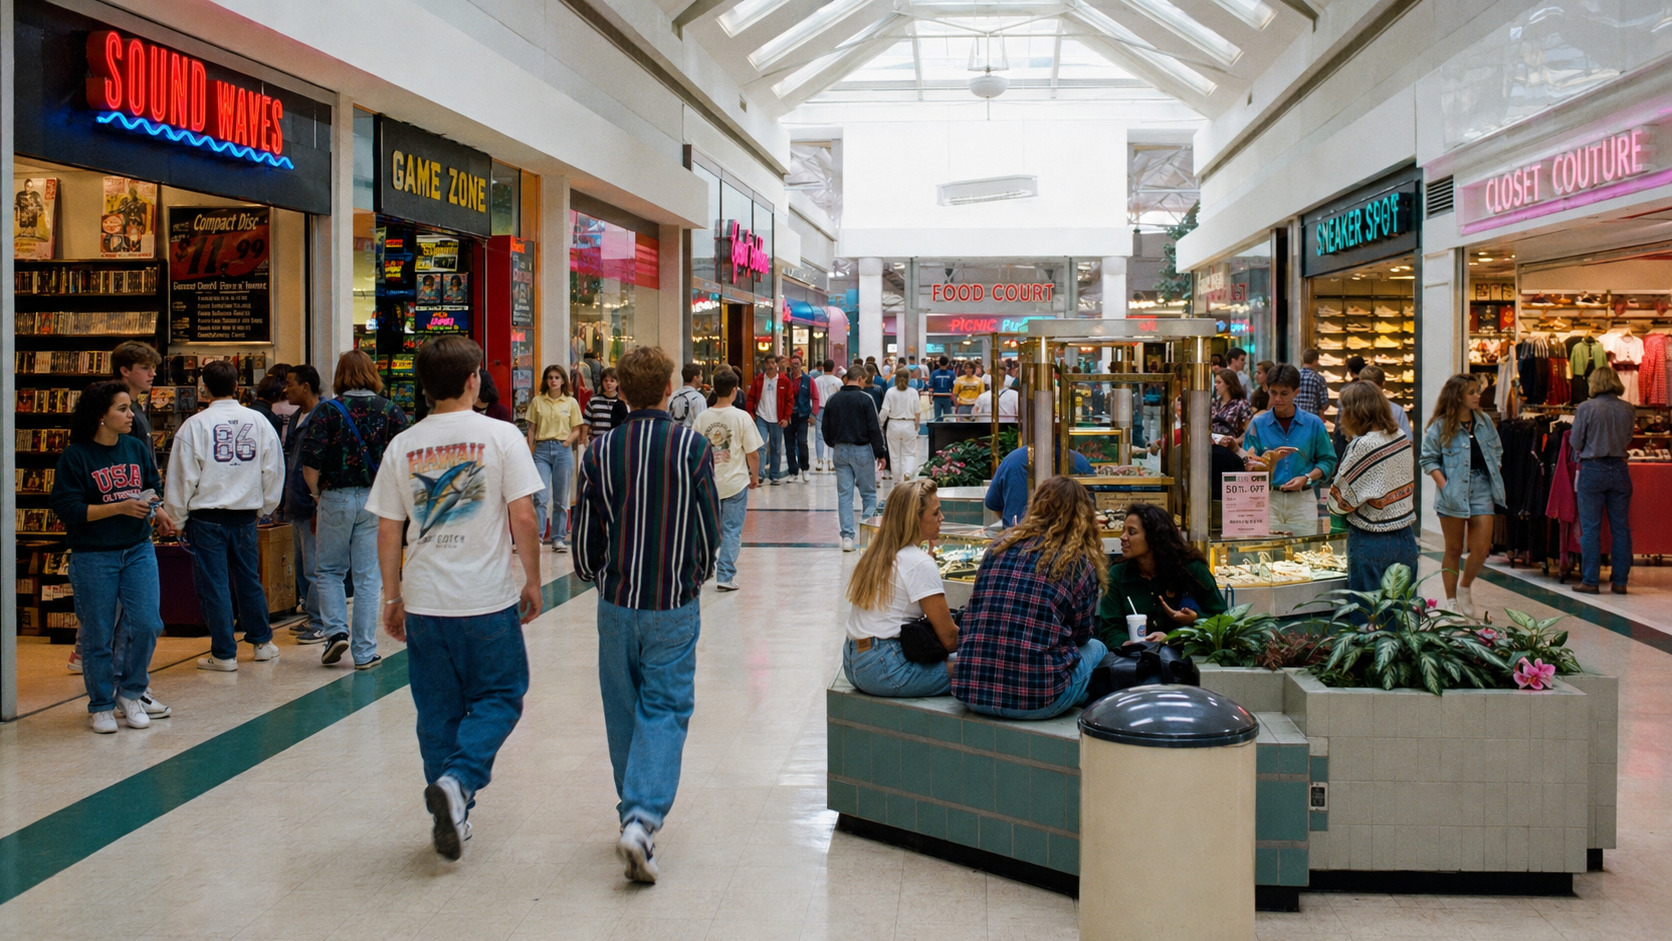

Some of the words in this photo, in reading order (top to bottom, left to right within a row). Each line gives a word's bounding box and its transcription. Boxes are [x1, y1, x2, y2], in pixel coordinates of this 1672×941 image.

[105, 31, 207, 132] SOUND
[217, 80, 284, 155] WAVES
[393, 150, 441, 200] GAME
[449, 167, 486, 213] ZONE
[1486, 164, 1541, 214] CLOSET
[1552, 130, 1643, 195] COUTURE
[193, 213, 237, 233] Compact
[238, 213, 259, 230] Disc
[1316, 208, 1363, 256] SNEAKER
[1365, 192, 1399, 241] SPOT
[932, 283, 984, 302] FOOD
[992, 283, 1055, 302] COURT
[949, 317, 997, 333] PICNIC
[213, 423, 256, 463] 86
[407, 442, 486, 480] HAWAII
[91, 463, 143, 494] USA
